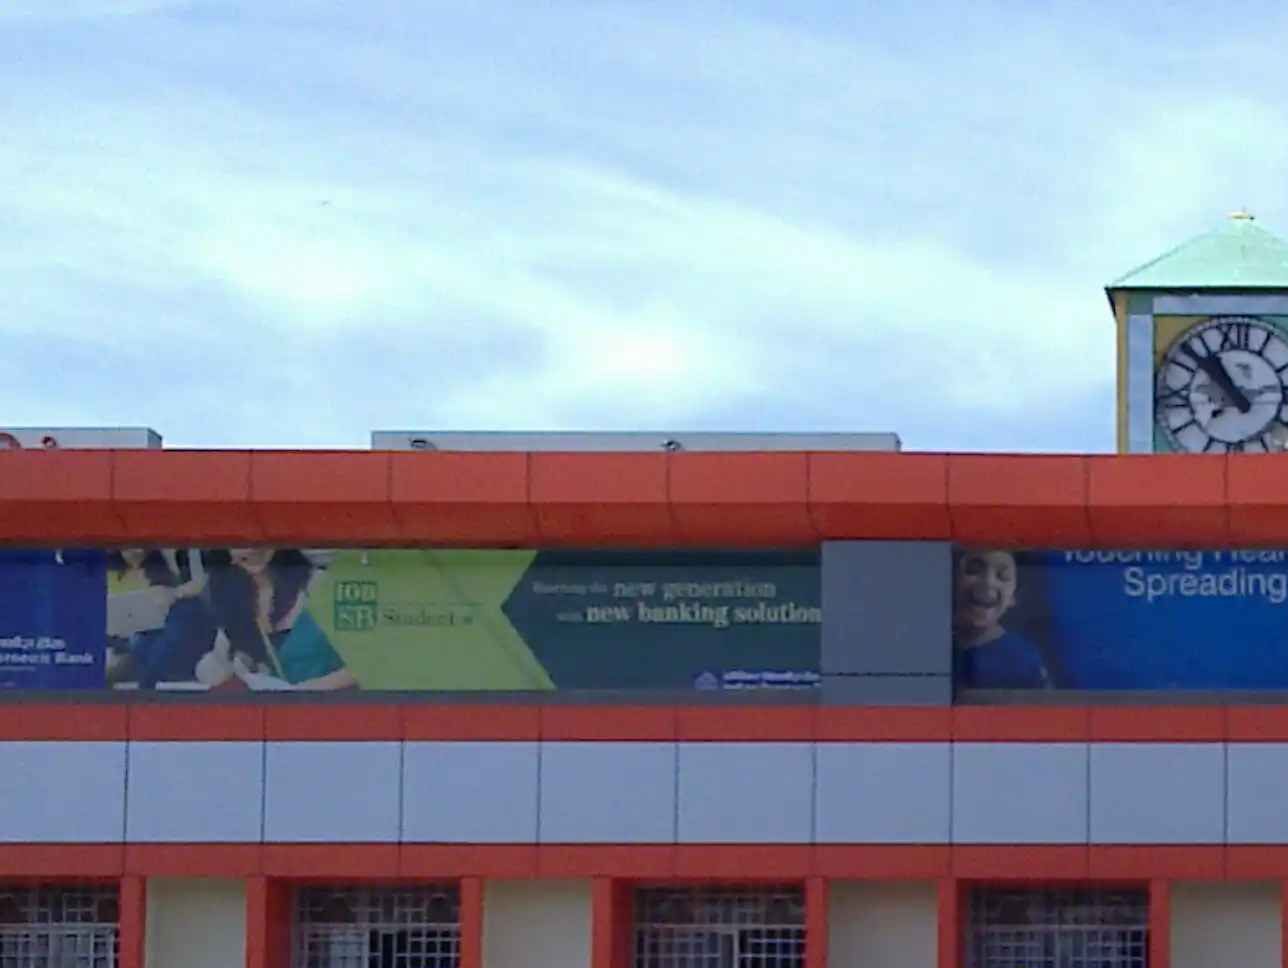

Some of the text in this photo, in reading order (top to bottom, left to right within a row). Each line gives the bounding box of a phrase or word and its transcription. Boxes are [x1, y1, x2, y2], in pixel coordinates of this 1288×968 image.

[613, 582, 655, 598] new
[662, 579, 777, 600] generation
[1124, 566, 1288, 603] Spreading
[586, 605, 630, 623] new
[637, 602, 729, 627] banking
